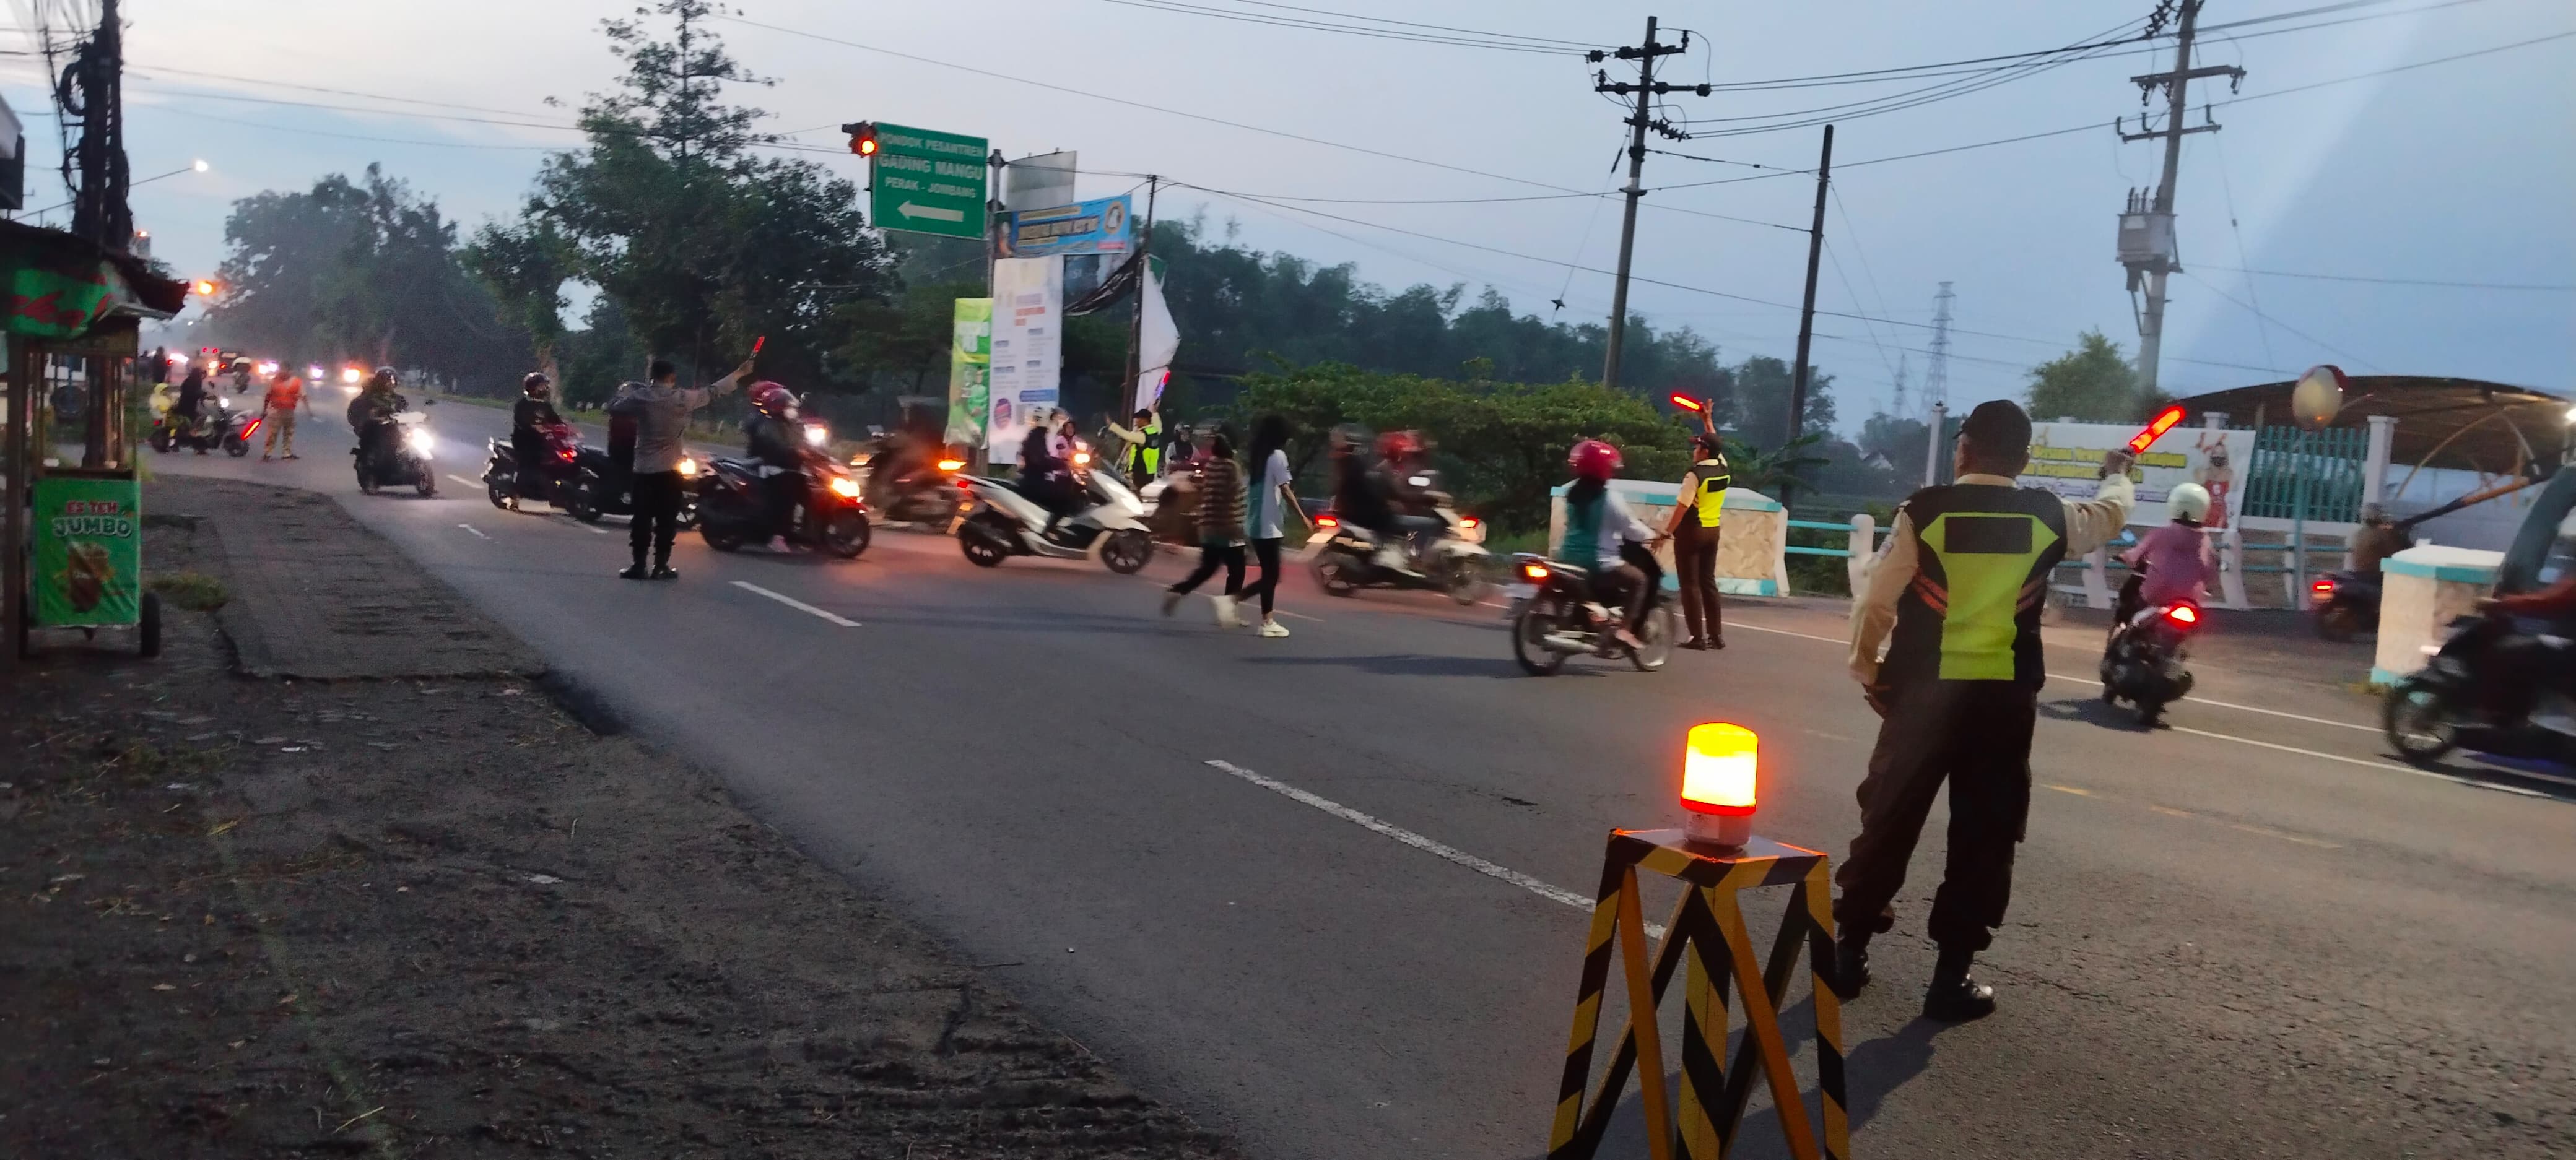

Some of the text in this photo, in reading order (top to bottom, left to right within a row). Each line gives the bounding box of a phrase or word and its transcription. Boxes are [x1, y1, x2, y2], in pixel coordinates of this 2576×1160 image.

[925, 139, 985, 157] PESANTREN
[878, 154, 983, 180] GADING MANGU
[884, 176, 919, 191] PERAK
[928, 183, 977, 198] JOMBANG
[66, 500, 118, 515] ES TEH
[52, 516, 133, 538] JUMBO
